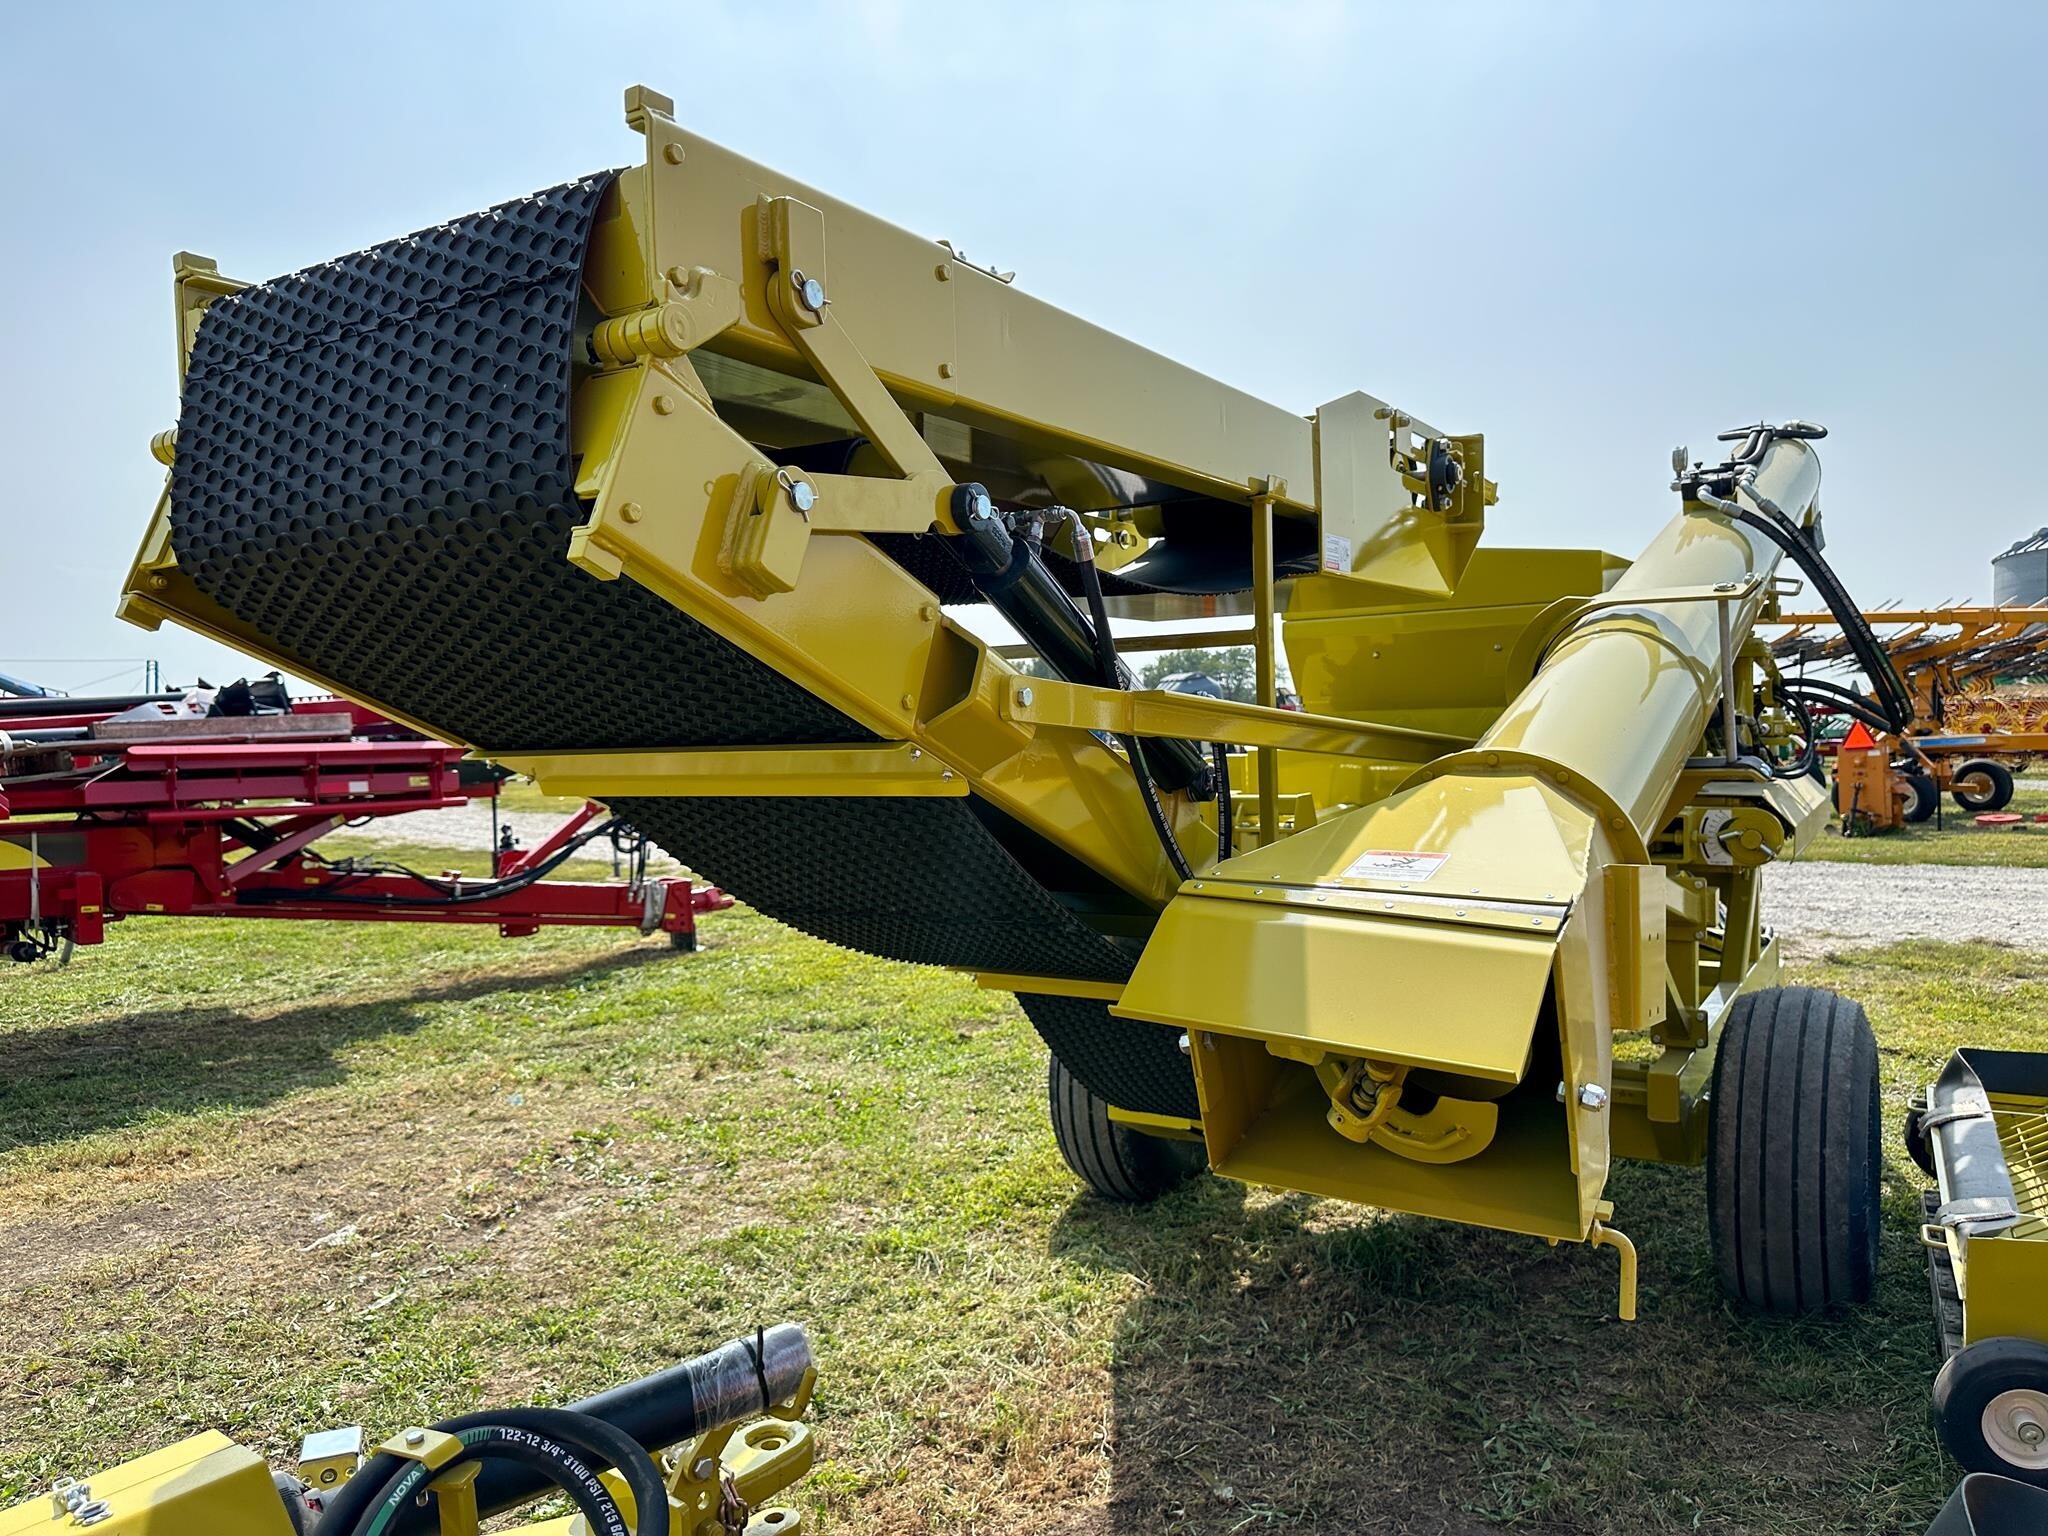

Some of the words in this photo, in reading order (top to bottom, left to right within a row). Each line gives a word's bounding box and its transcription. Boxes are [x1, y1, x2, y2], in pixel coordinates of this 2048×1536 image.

[388, 1470, 421, 1506] NOVA
[499, 1428, 541, 1447] 122-12
[540, 1440, 566, 1457] 3/4"
[563, 1455, 590, 1481] 3100
[585, 1478, 604, 1498] PSI
[600, 1502, 619, 1523] 215
